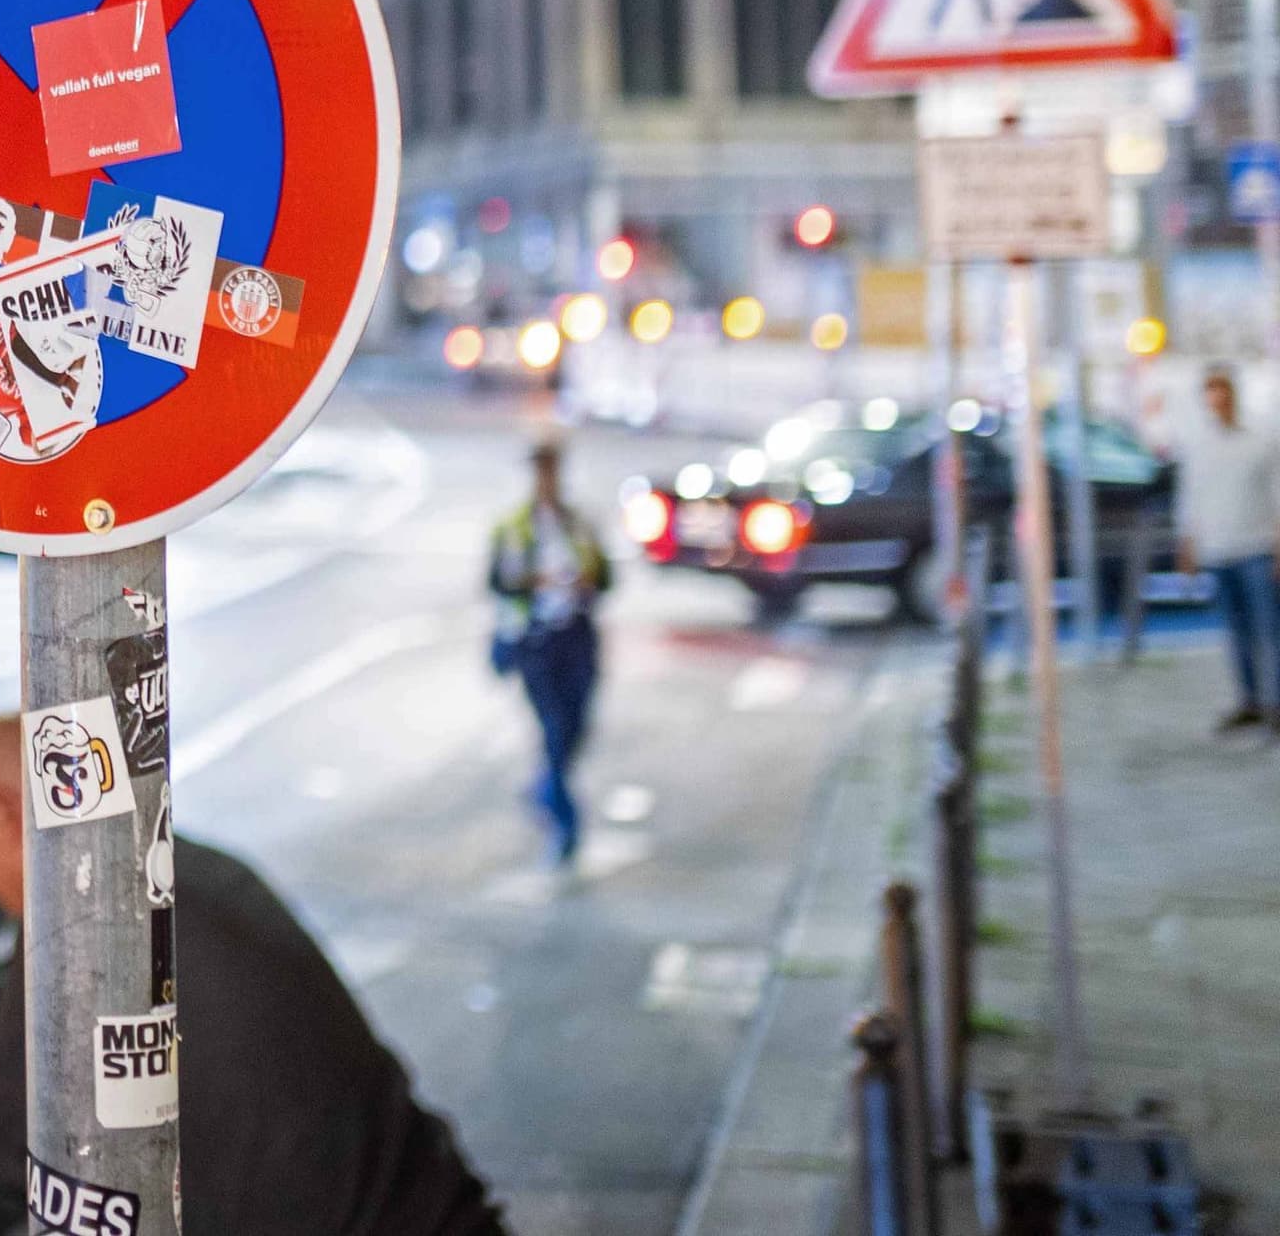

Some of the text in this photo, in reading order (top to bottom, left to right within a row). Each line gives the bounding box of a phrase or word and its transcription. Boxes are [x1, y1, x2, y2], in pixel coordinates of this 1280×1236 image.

[50, 62, 161, 98] vallah full vegan
[224, 279, 238, 294] FC
[255, 272, 279, 308] PAULI
[136, 325, 187, 357] LINE
[232, 317, 261, 333] 1910
[102, 1047, 172, 1079] STO
[27, 1155, 134, 1236] ADES
